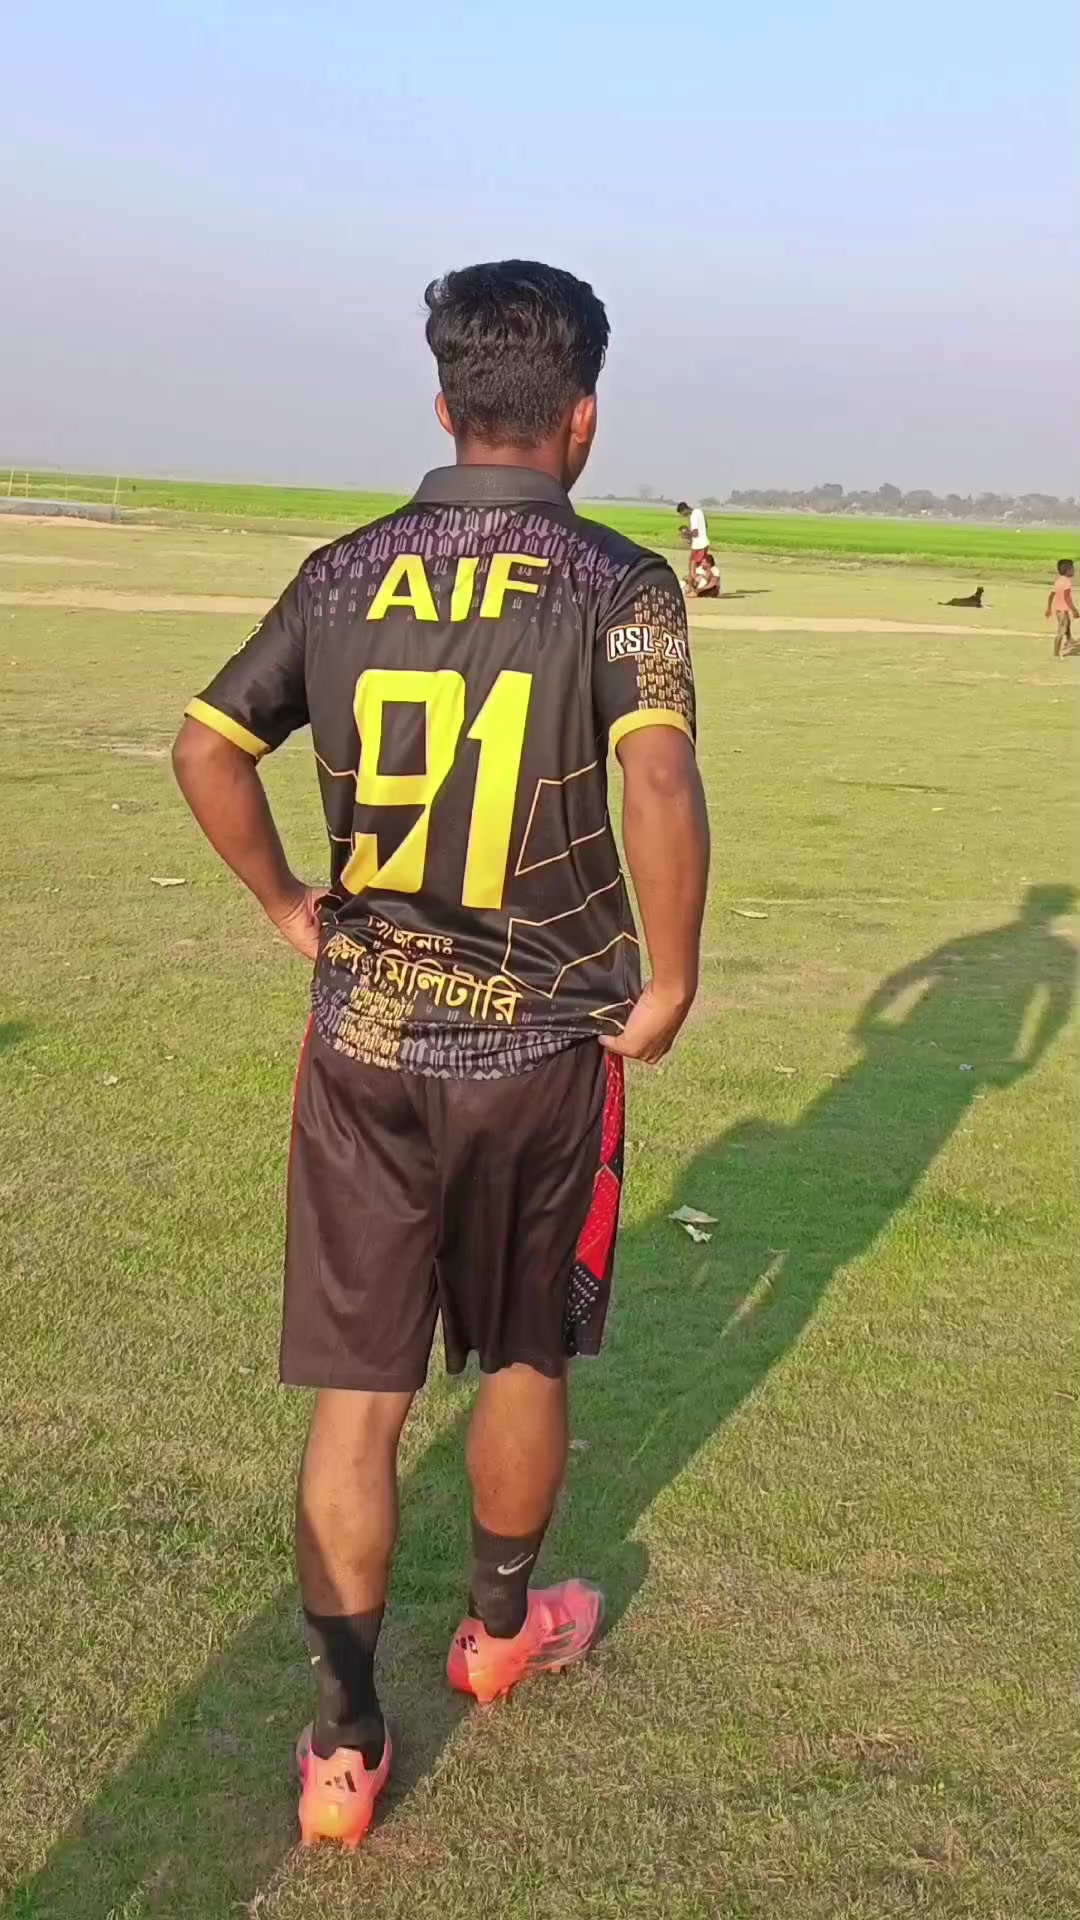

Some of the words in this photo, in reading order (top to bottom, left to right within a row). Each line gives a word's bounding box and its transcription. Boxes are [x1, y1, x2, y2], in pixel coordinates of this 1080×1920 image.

[366, 553, 550, 622] AIF
[340, 669, 533, 910] 91
[374, 948, 524, 1025] মিলিটারি
